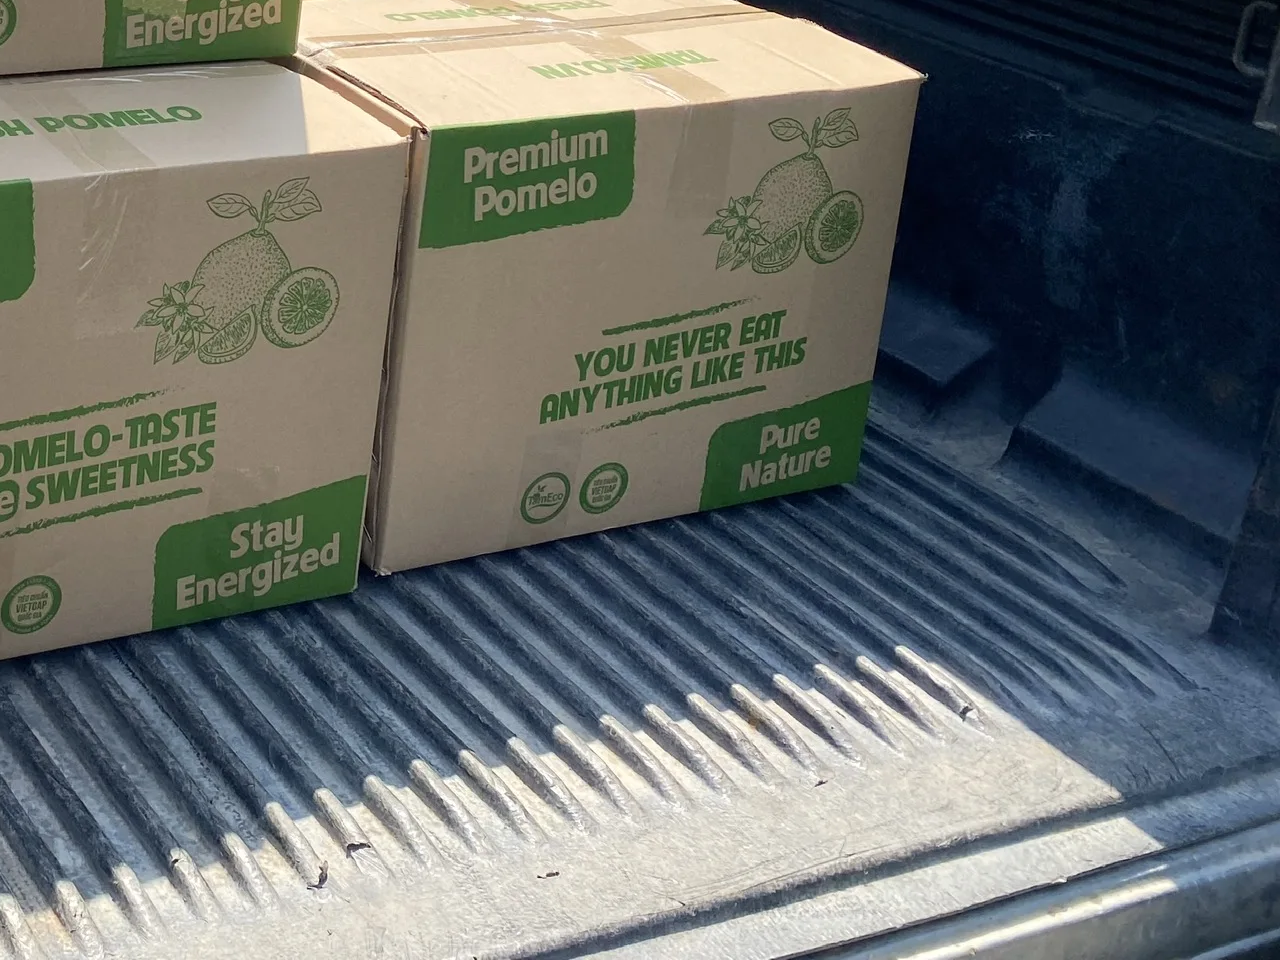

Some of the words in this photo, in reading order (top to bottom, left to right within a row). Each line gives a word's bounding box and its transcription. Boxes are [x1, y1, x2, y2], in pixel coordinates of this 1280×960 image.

[384, 5, 517, 22] POMELO
[513, 0, 613, 14] FRESH
[32, 105, 203, 133] POMELO
[463, 129, 608, 184] Premium
[474, 167, 598, 222] Pomelo
[574, 342, 636, 382] YOU
[643, 321, 732, 368] NEVER
[739, 309, 788, 347] EAT
[539, 365, 683, 425] ANYTHING
[690, 351, 746, 390] LIKE
[754, 336, 808, 374] THIS
[758, 417, 821, 455] Pure
[25, 439, 216, 510] SWEETNESS
[739, 445, 832, 493] Nature
[230, 514, 304, 559] Stay
[176, 531, 341, 611] Energized
